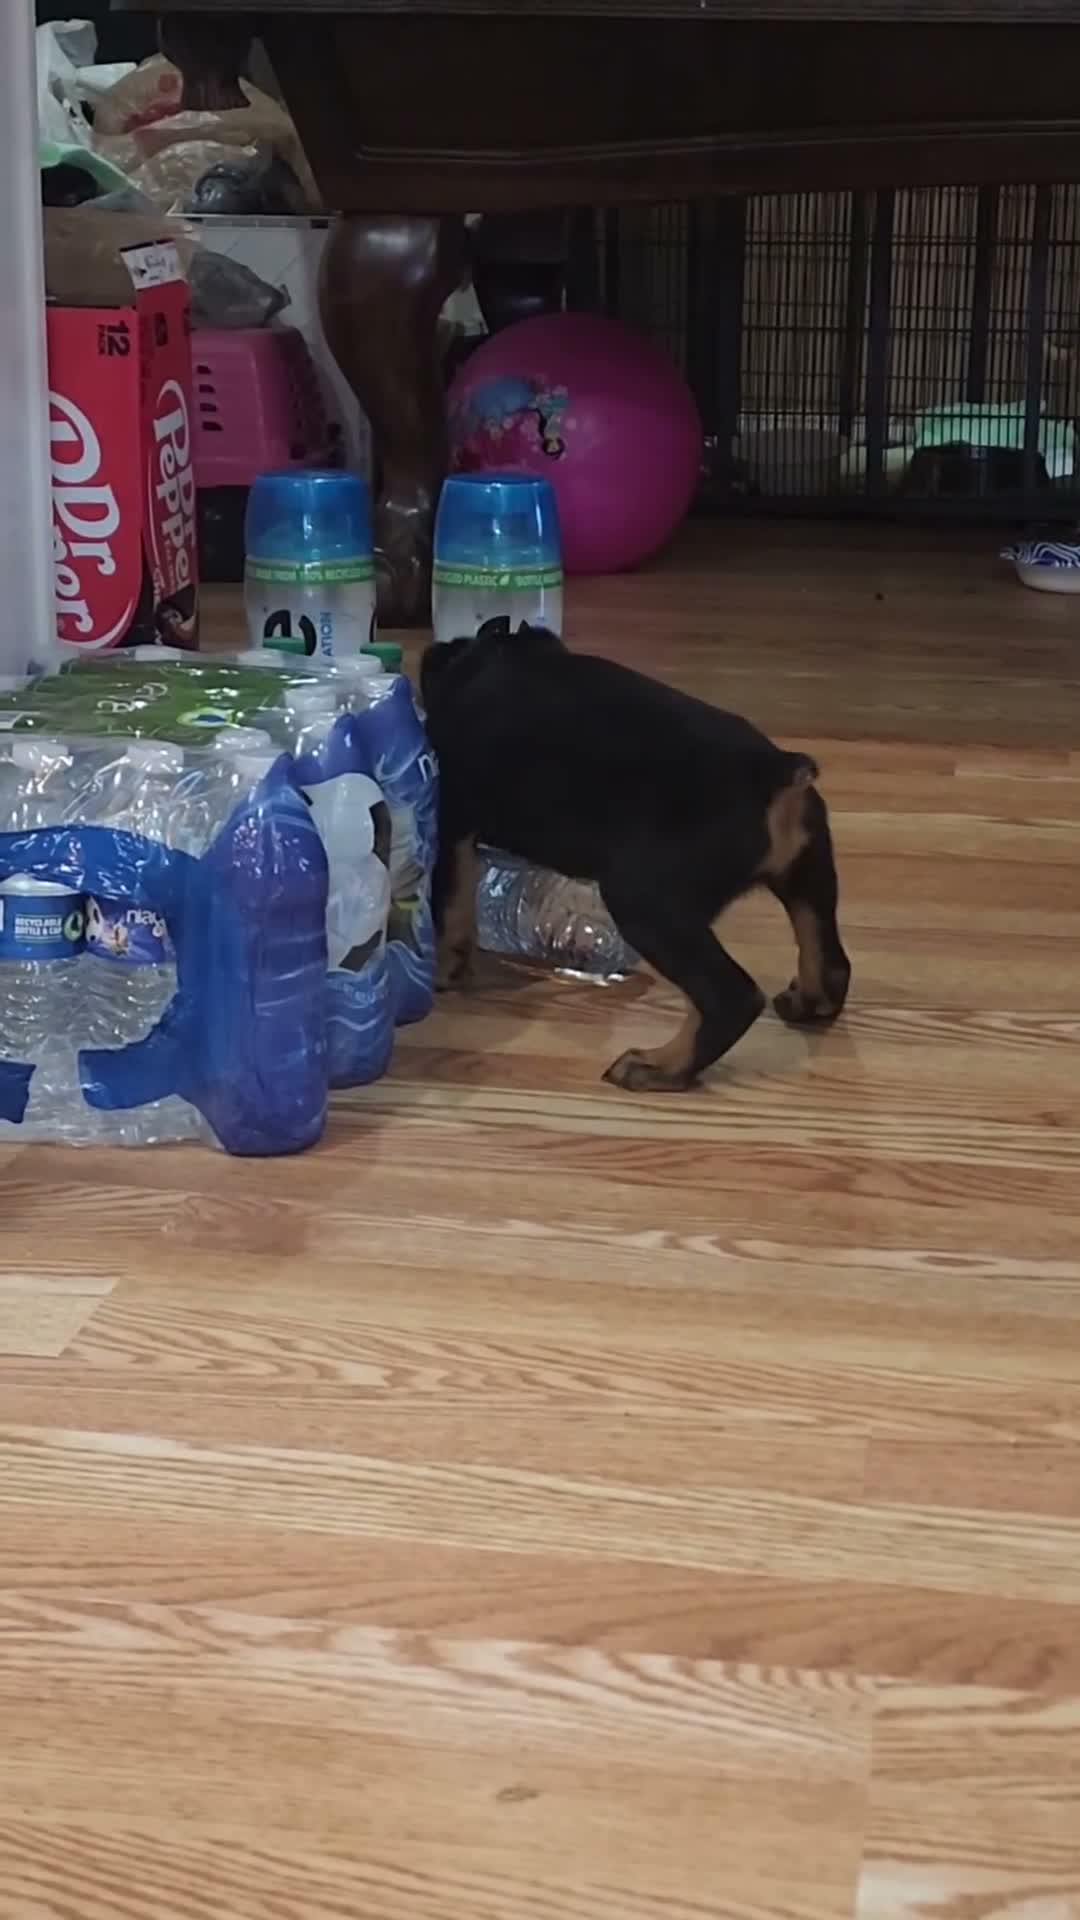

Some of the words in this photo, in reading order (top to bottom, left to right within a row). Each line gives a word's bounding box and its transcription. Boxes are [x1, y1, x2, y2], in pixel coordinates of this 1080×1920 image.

[107, 319, 130, 357] 12
[52, 483, 121, 576] Dr
[463, 574, 498, 587] PLASTIC
[320, 612, 334, 660] ATION
